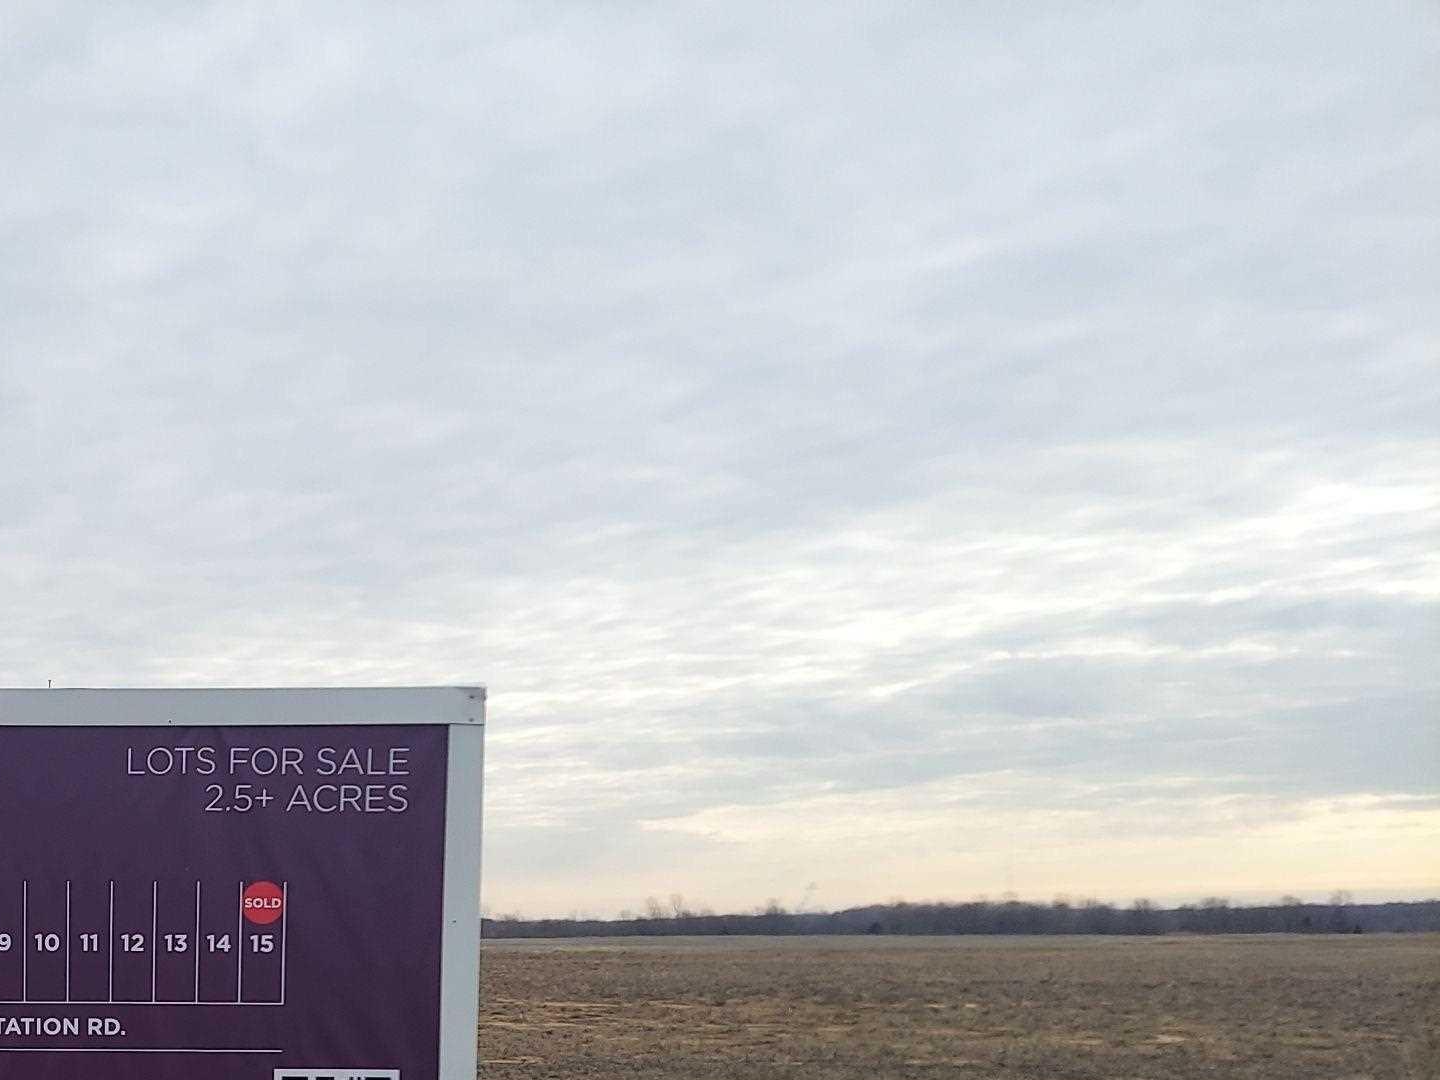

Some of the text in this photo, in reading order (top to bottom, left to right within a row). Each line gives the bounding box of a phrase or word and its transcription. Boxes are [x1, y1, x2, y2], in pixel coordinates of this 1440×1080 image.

[126, 747, 410, 776] LOTS FOR SALE
[204, 784, 409, 813] 2.5+ ACRES
[244, 896, 282, 909] SOLD
[34, 933, 60, 951] 10
[79, 934, 99, 952] 11
[121, 934, 145, 952] 12
[164, 934, 188, 952] 13
[206, 934, 232, 952] 14
[250, 934, 274, 952] 15
[88, 1018, 127, 1036] RD.
